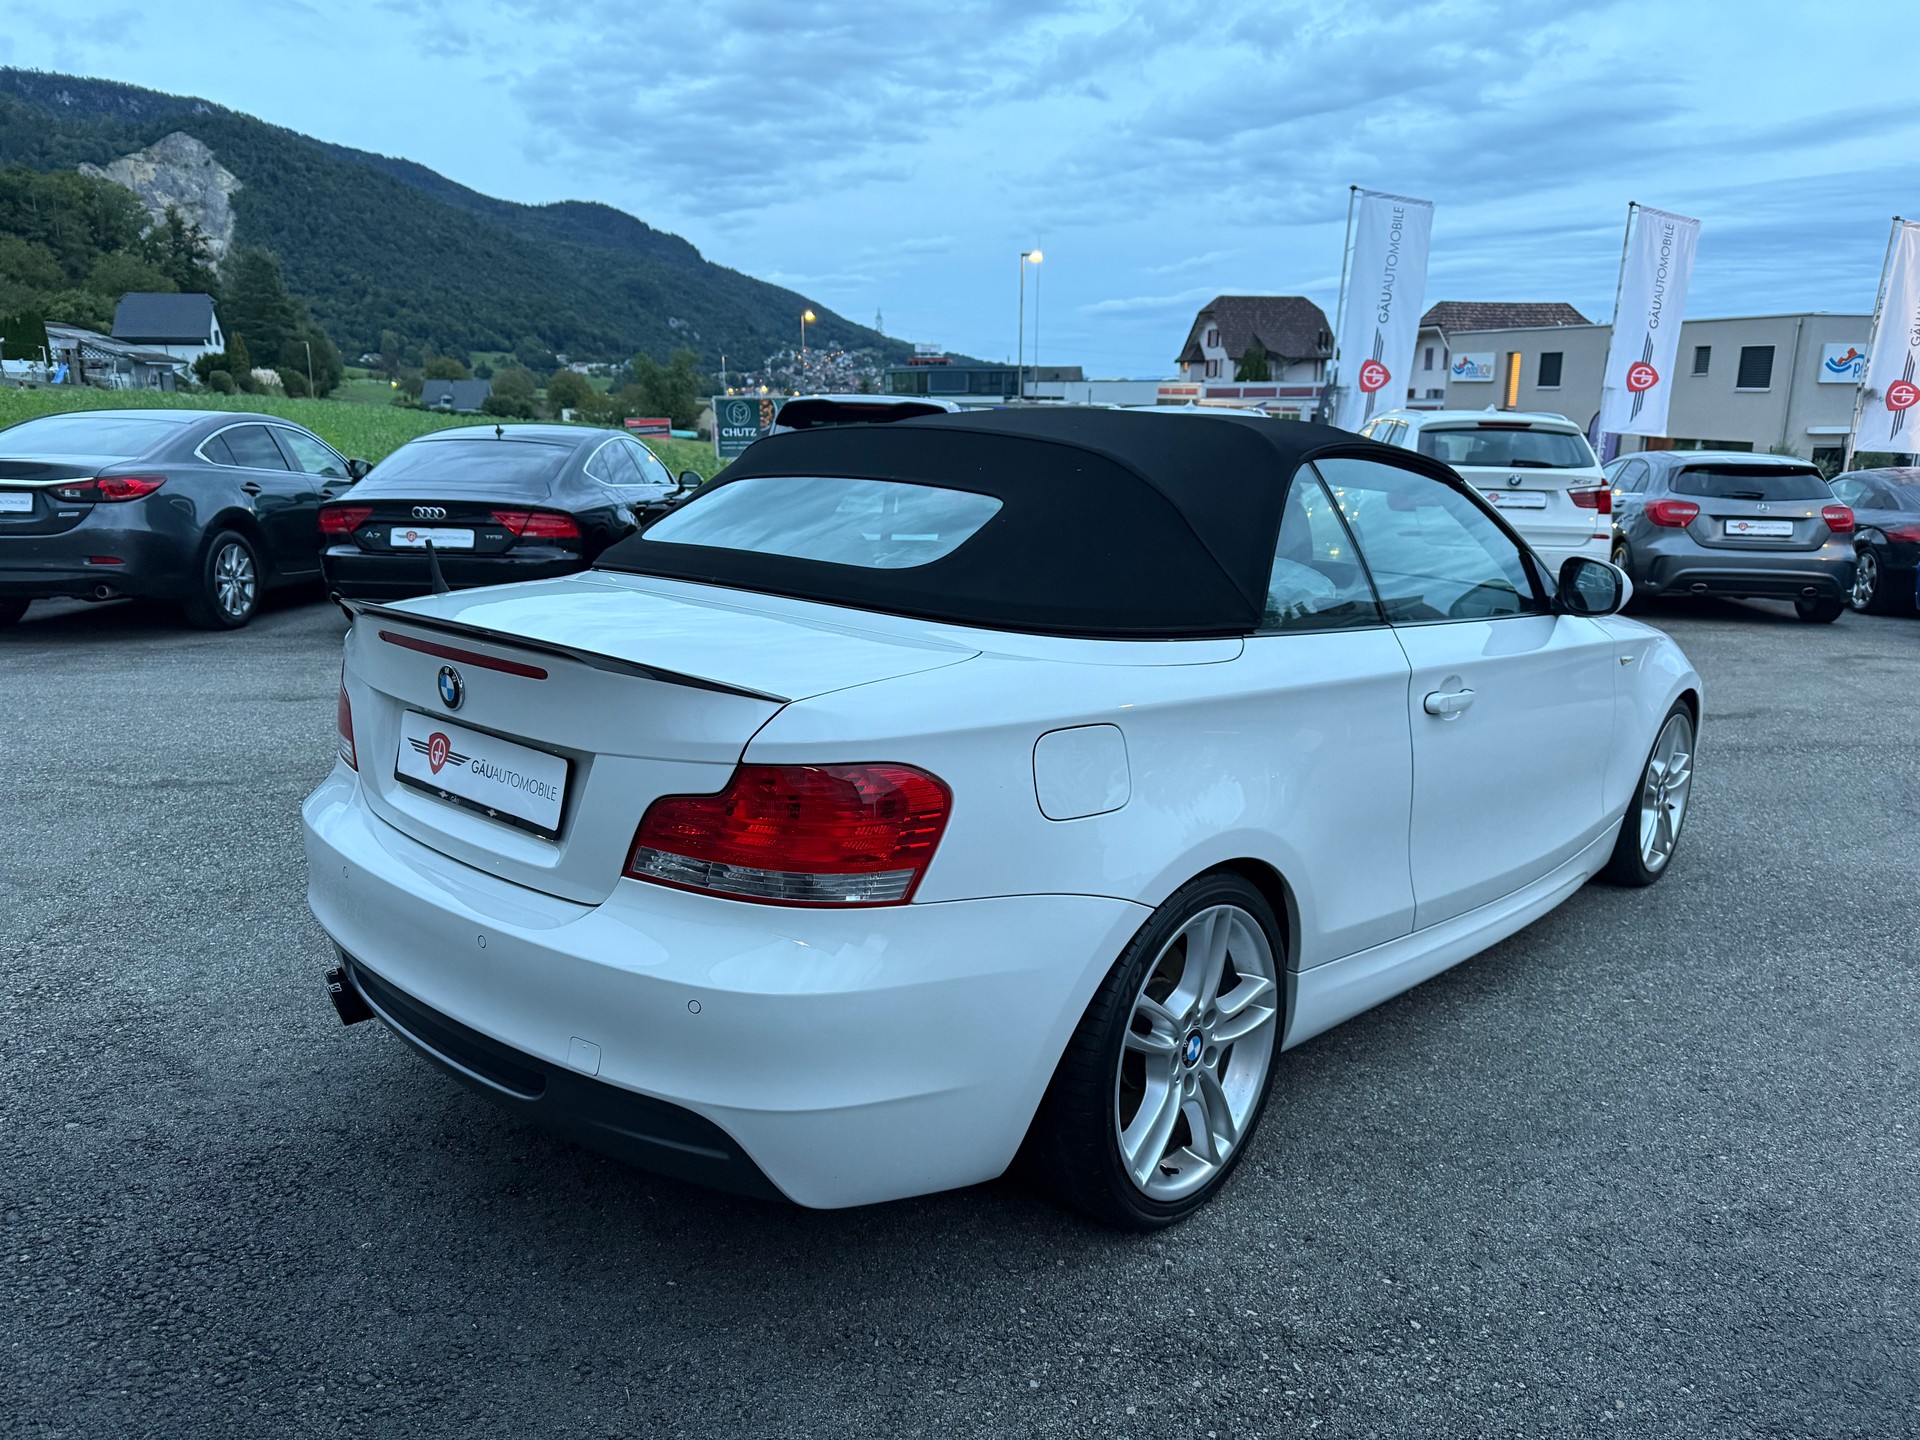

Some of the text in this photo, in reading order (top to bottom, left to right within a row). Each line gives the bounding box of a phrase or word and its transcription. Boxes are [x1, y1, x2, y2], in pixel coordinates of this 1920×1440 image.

[1377, 206, 1405, 324] GÄUAUTOMOBILE
[1648, 223, 1674, 329] GÄUAUTOMOBILE
[721, 427, 757, 437] CHUTZ
[365, 531, 381, 539] A7
[471, 759, 557, 801] GÄUAUTOMOBILE
